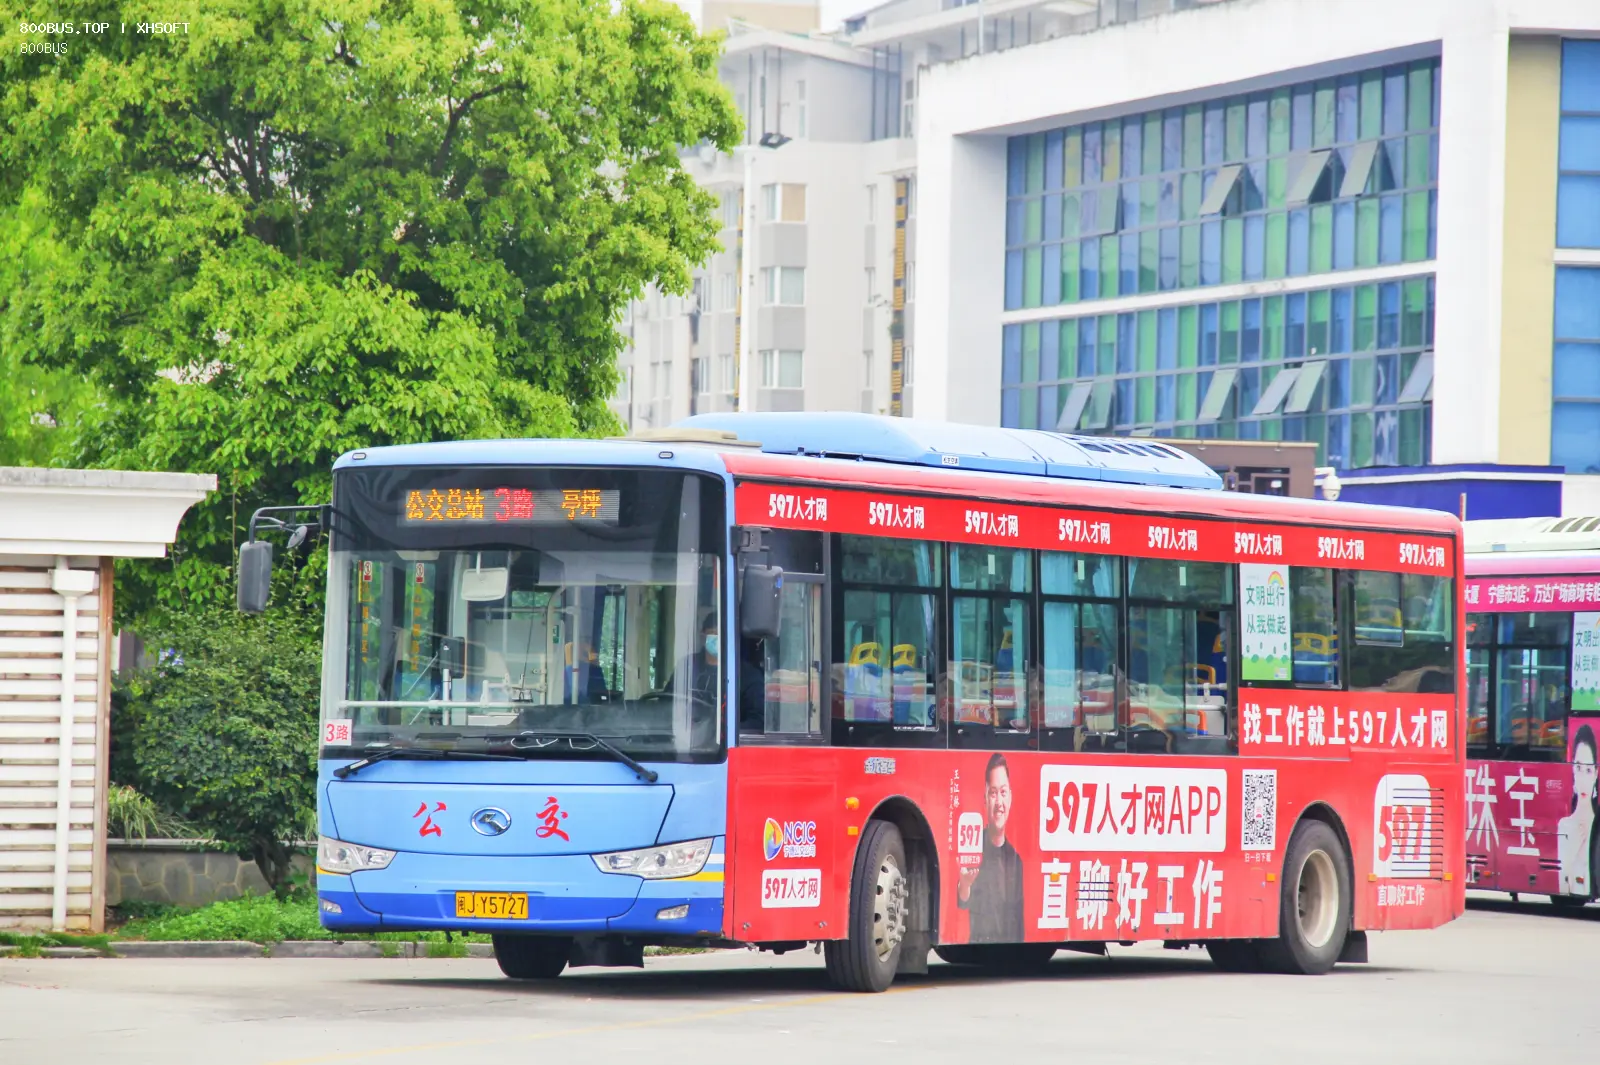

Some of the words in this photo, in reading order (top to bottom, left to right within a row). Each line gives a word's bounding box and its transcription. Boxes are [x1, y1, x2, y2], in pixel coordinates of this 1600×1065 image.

[405, 488, 485, 520] 公交总站
[494, 488, 535, 521] 3路
[768, 493, 827, 521] 597人才网
[869, 501, 925, 529] 597人才网
[964, 510, 1019, 537] 597人才网
[1058, 518, 1112, 545] 597人才网
[1147, 526, 1198, 552] 597人才网
[1234, 532, 1283, 556] 597人才网
[1317, 536, 1365, 561] 597人才网
[1399, 541, 1445, 567] 597人才网
[1245, 585, 1285, 607] 文明出行
[1246, 614, 1287, 635] 从我做起
[325, 723, 349, 742] 3路
[1243, 703, 1448, 748] 找工作就上597人才网
[412, 801, 447, 838] 公
[535, 796, 570, 842] 交
[1045, 781, 1222, 835] 597人才网APP
[784, 821, 816, 845] NCIC
[960, 824, 981, 847] 597
[1378, 805, 1427, 863] 597
[764, 877, 818, 900] 597人才网
[1037, 857, 1224, 931] 直聊好工作
[1377, 884, 1426, 907] 直聊好工作
